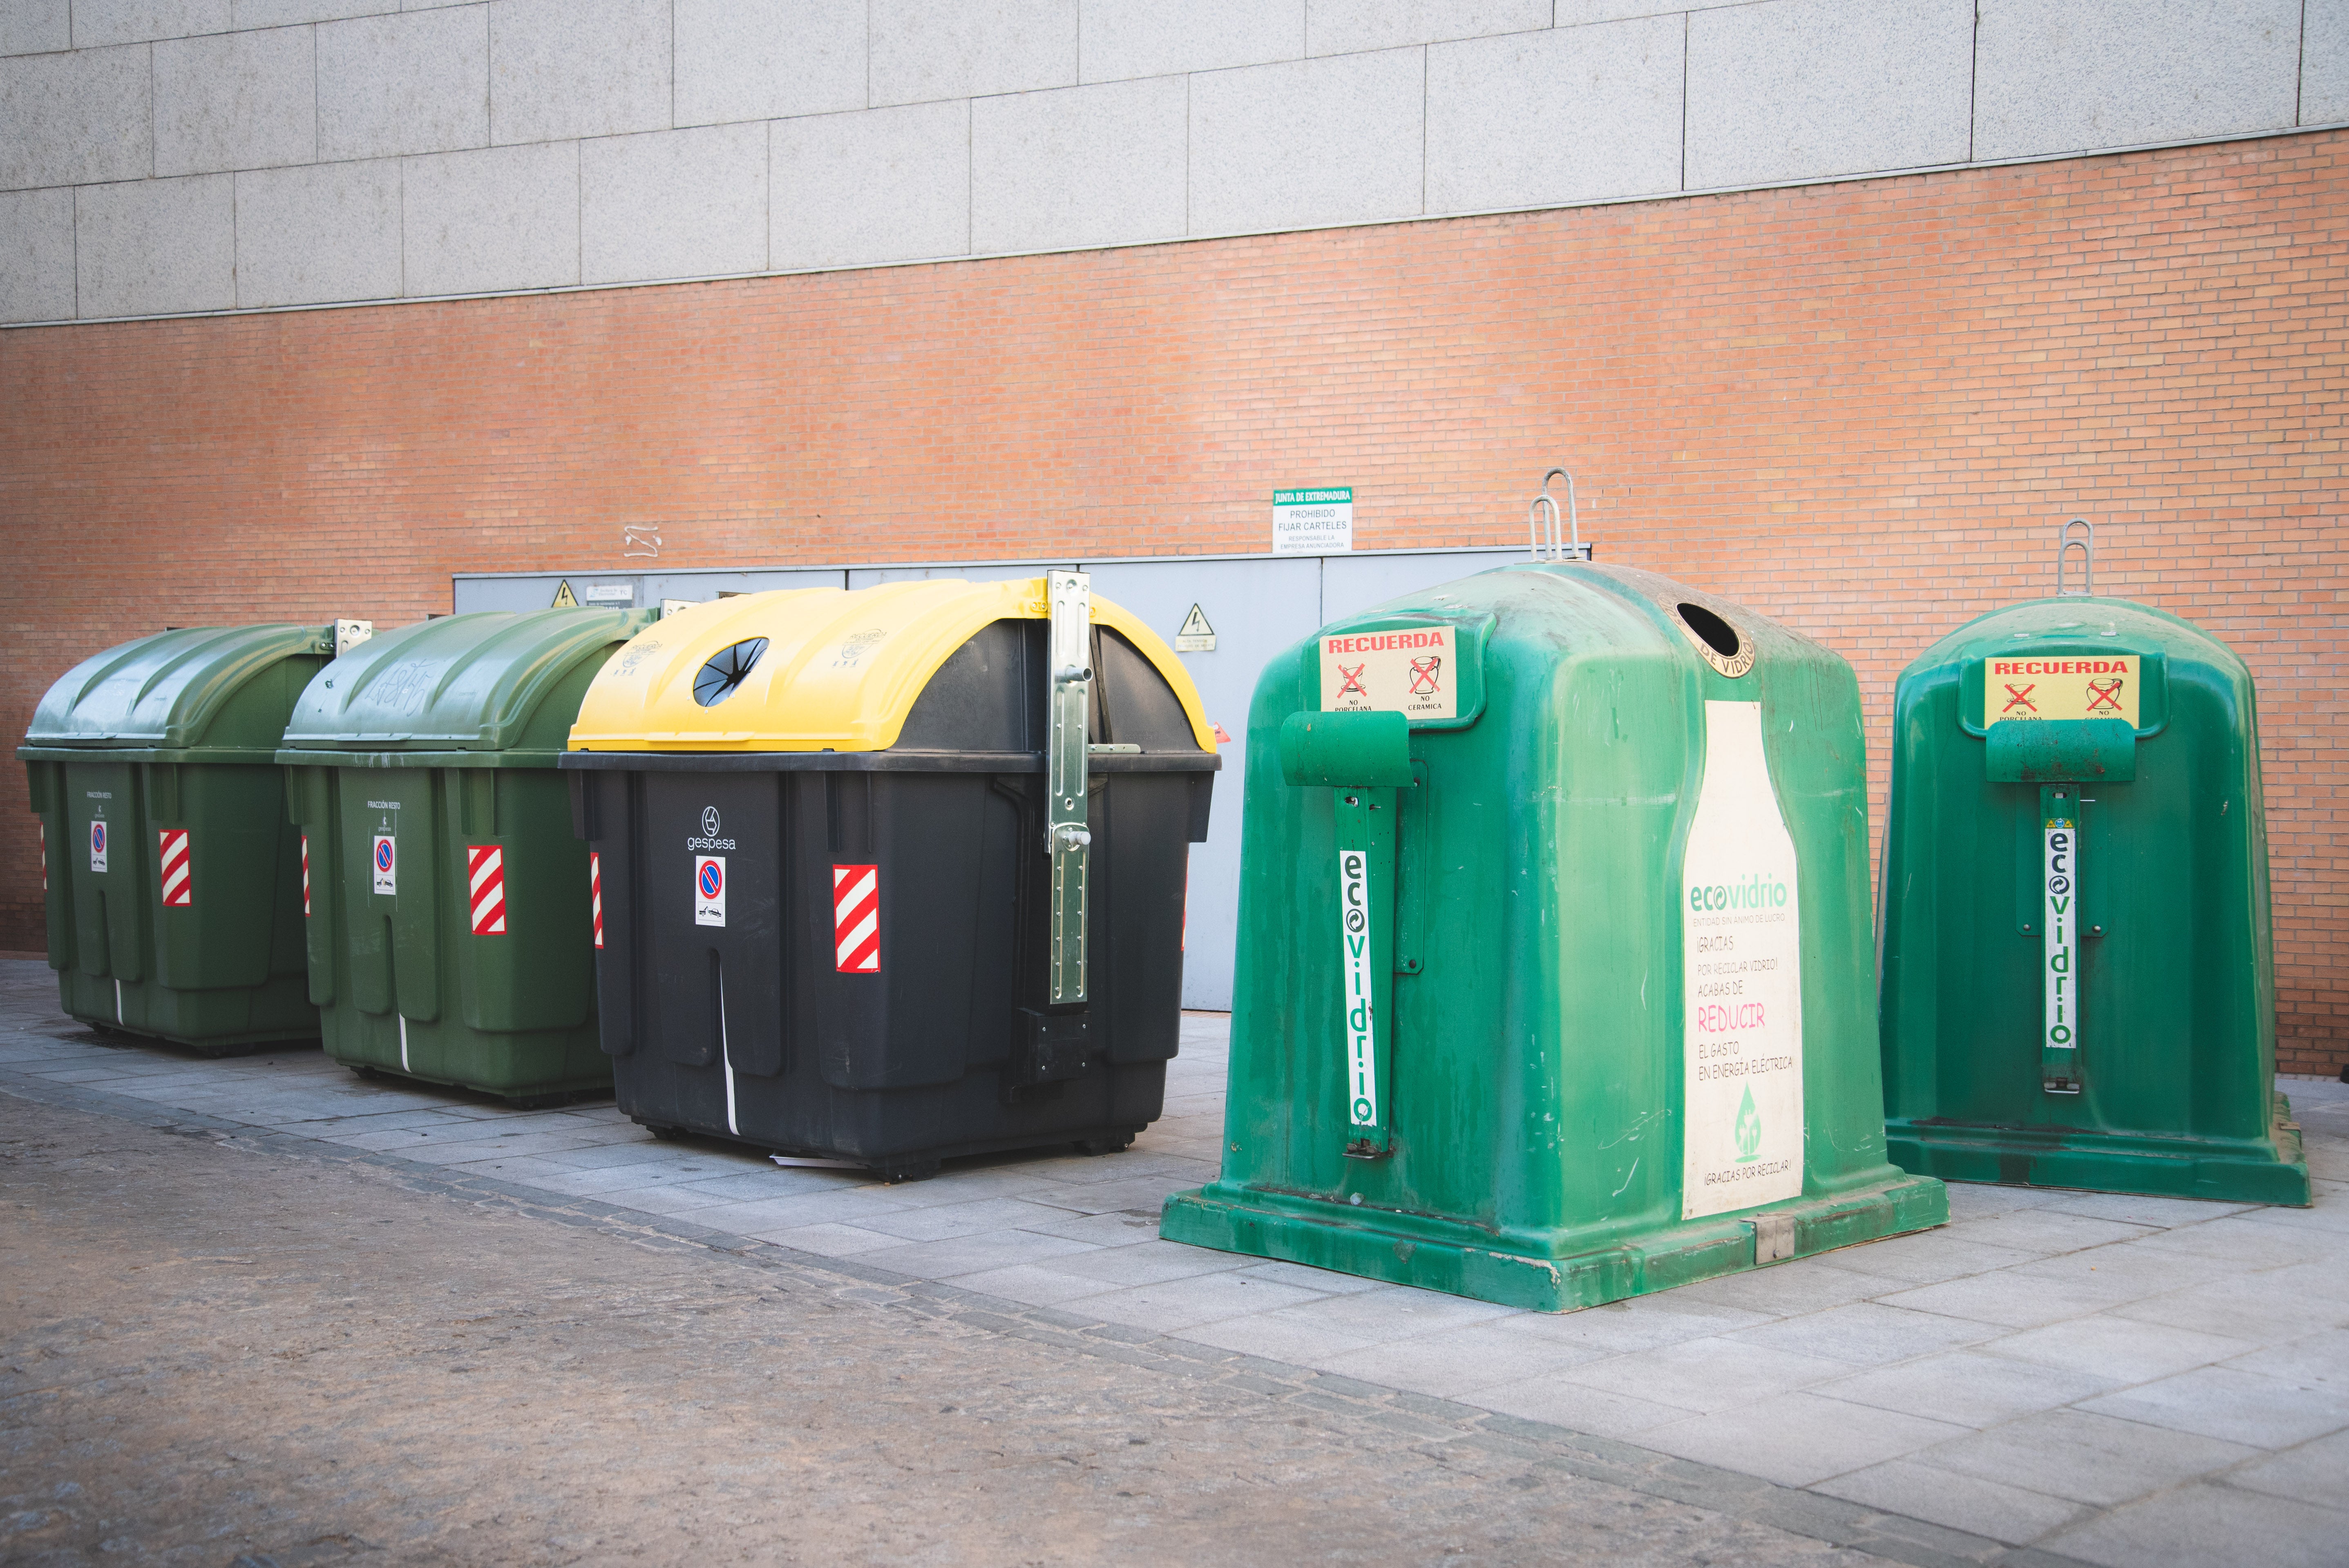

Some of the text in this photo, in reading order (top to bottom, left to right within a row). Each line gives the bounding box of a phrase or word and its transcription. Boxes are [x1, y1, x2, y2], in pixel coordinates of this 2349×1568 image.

[1275, 491, 1350, 504] JUNTA DE EXTREMADURA
[1290, 509, 1335, 518] PROHIBIDO
[1279, 521, 1347, 531] FIJAR CARTELES
[1328, 632, 1444, 654] RECUERDA
[1700, 641, 1754, 674] DE VIDRIO
[1995, 661, 2128, 675] RECUERDA
[368, 800, 388, 809] FRACCIÓN
[688, 837, 736, 851] gespesa
[1690, 873, 1787, 911] ecovidrio
[1693, 917, 1720, 927] ENTIDAD
[1722, 916, 1732, 925] SIN
[1756, 914, 1763, 922] DE
[1765, 913, 1785, 922] LUCRO
[2049, 832, 2071, 1044] ecovidrio
[1698, 957, 1777, 976] POR RECICLAR VIDRIO!
[1345, 855, 1372, 1122] ecovidrio
[1698, 980, 1743, 997] ACABAS DE
[1698, 1003, 1765, 1032] REDUCIR
[1699, 1041, 1739, 1059] EL GASTO
[1699, 1053, 1792, 1081] EN ENERGÍA ELÉCTRICA
[1704, 1159, 1791, 1186] ¡GRACIAS POR RECICLAR!
